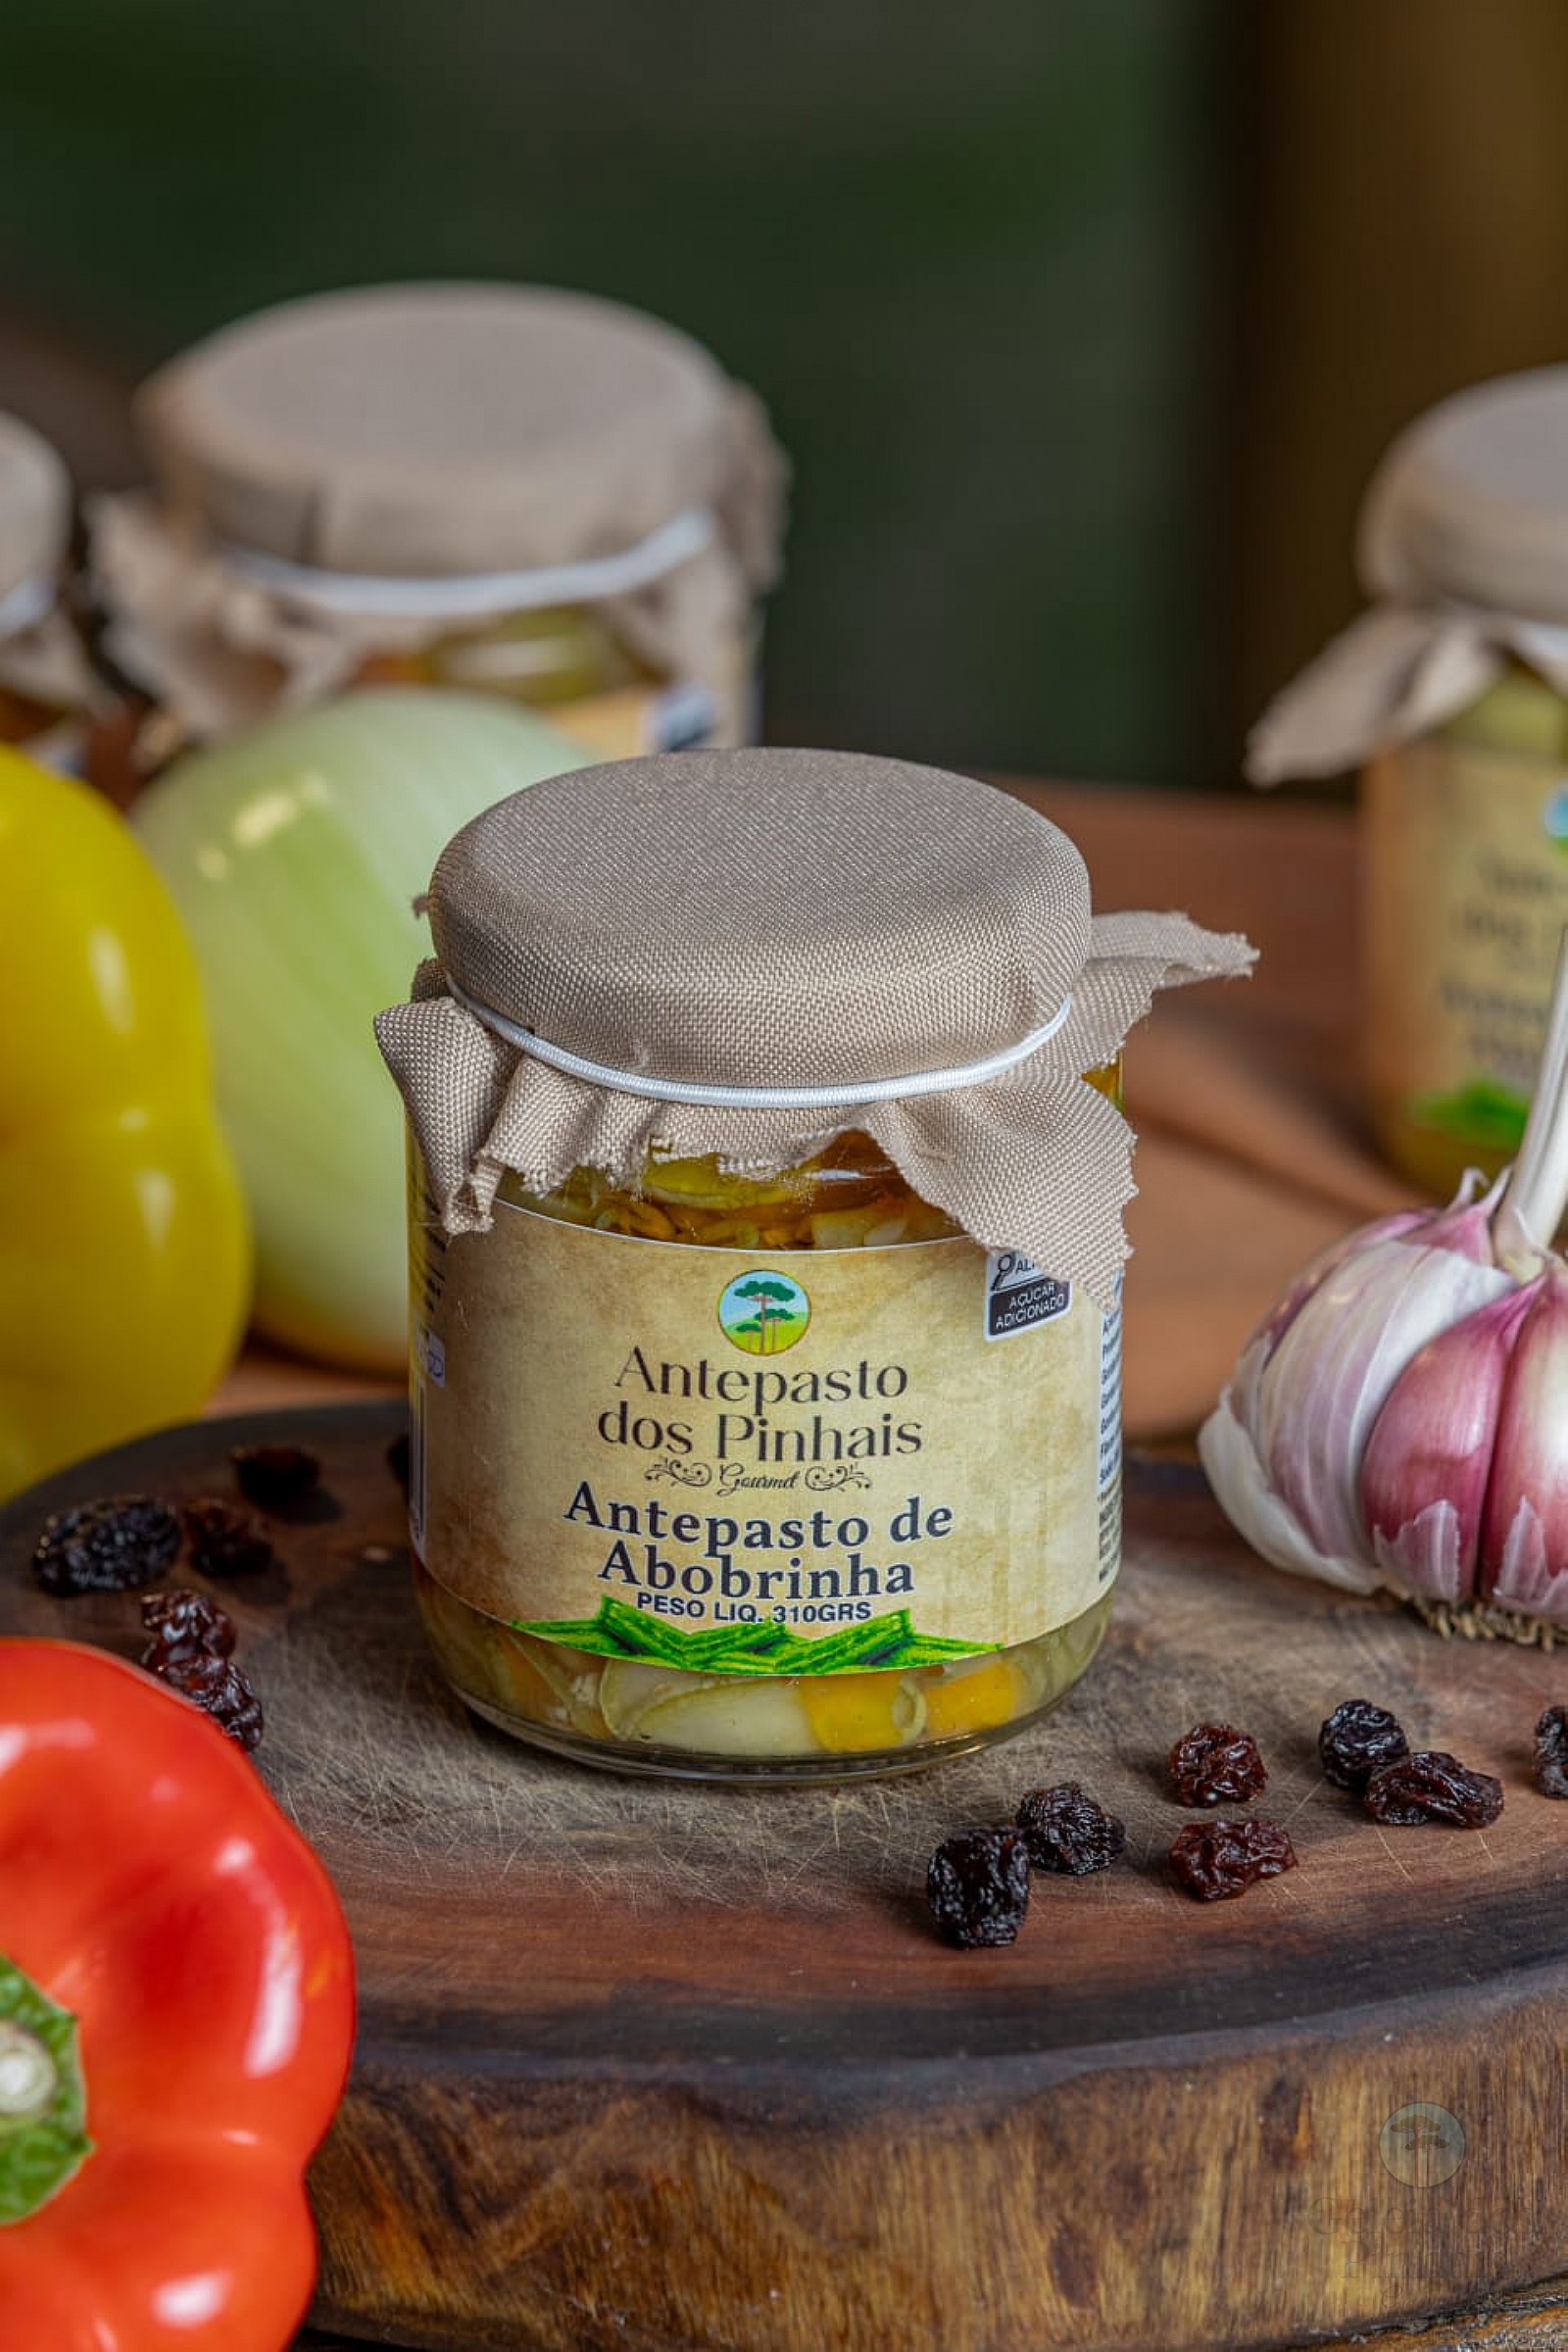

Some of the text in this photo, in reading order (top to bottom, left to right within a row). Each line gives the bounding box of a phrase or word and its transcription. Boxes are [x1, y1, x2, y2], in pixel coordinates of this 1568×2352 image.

[996, 1294, 1064, 1329] ADICIONADO
[614, 1345, 907, 1416] Antepasto
[598, 1400, 922, 1462] dos Pinhais
[563, 1480, 954, 1558] Antepasto de
[597, 1539, 915, 1600] Abobrinha
[637, 1592, 872, 1624] PESO LIQ. 310GRS
